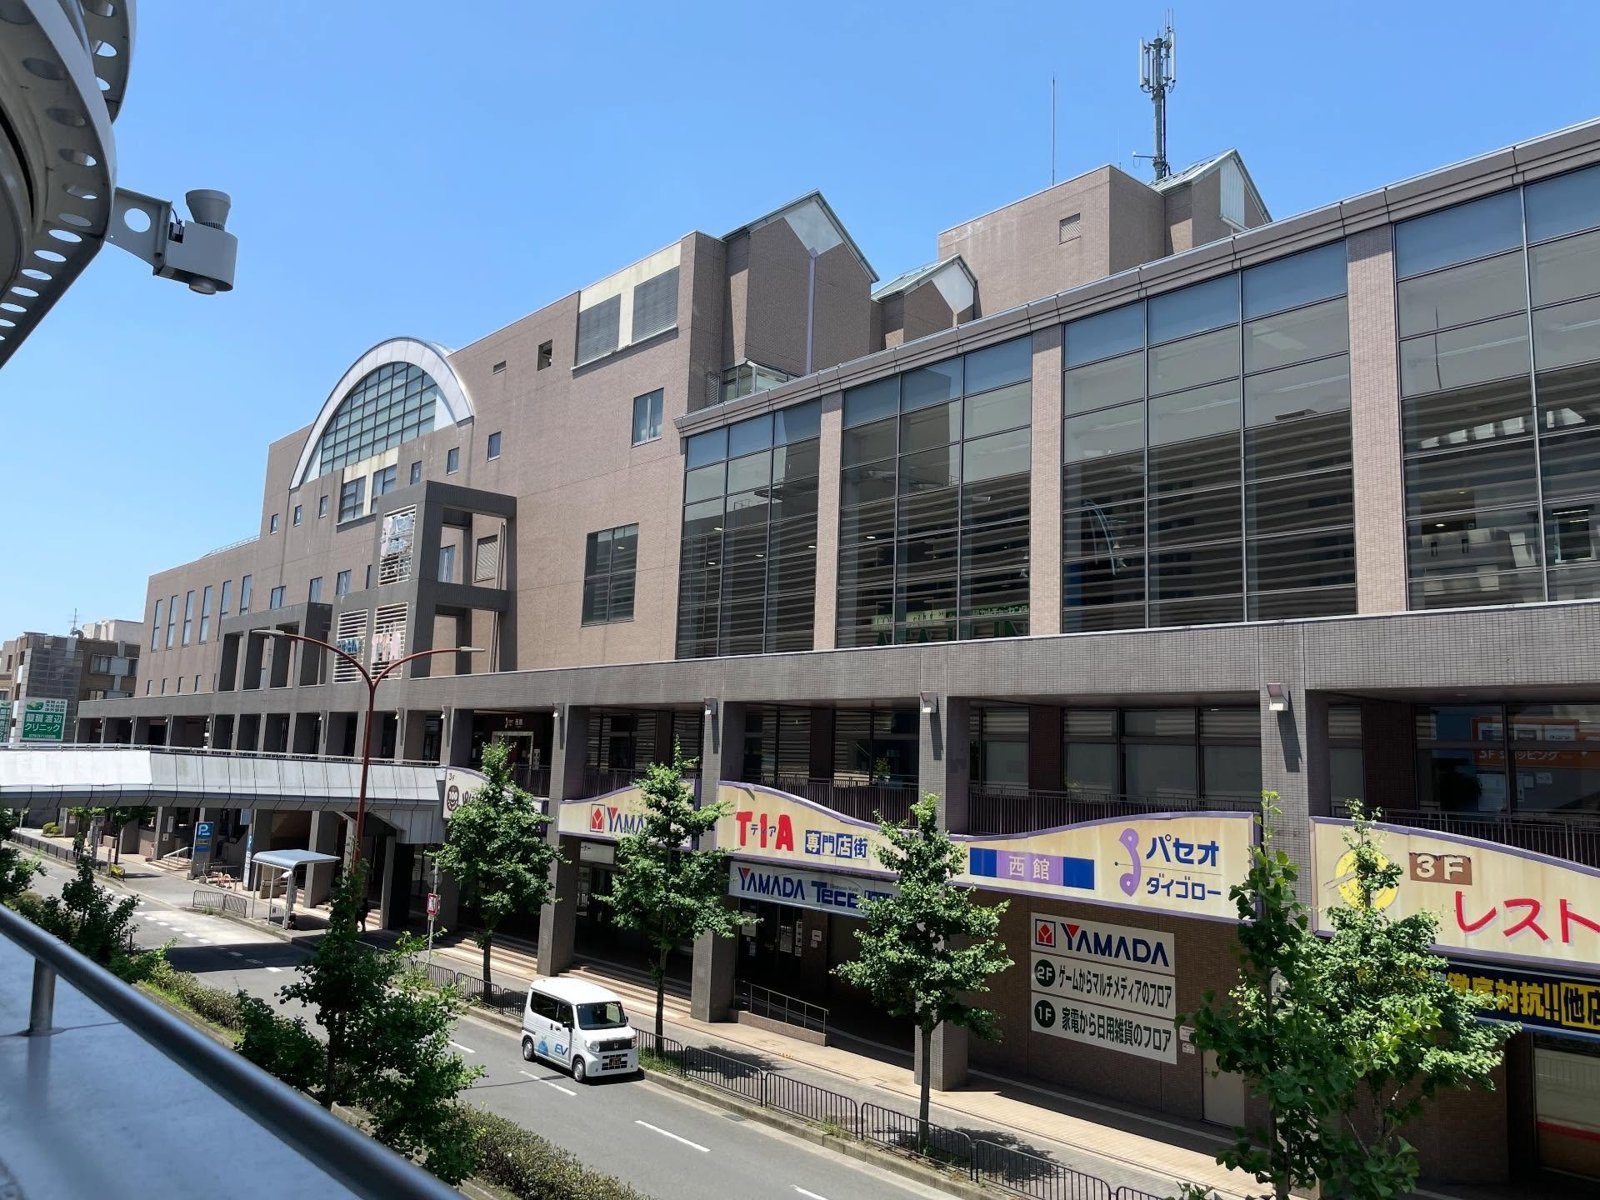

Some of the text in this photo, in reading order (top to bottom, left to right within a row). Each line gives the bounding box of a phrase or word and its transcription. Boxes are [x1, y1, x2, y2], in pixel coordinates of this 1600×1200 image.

[25, 723, 60, 732] クリニック
[736, 811, 794, 852] TIA
[805, 830, 868, 858] 専門店街
[1146, 834, 1220, 867] パセオ
[738, 867, 805, 900] YAMADA
[1009, 855, 1050, 881] 西館
[1416, 855, 1464, 881] 3F
[1146, 873, 1222, 900] ダイゴロー
[1455, 890, 1600, 943] レスト
[1060, 923, 1169, 967] YAMADA
[1036, 964, 1172, 1009] 2F ゲームからマルチメディアのフロア
[1038, 1005, 1052, 1022] 1F
[1061, 1006, 1172, 1053] 家電から日用雑貨のフロア
[554, 1044, 568, 1056] EV
